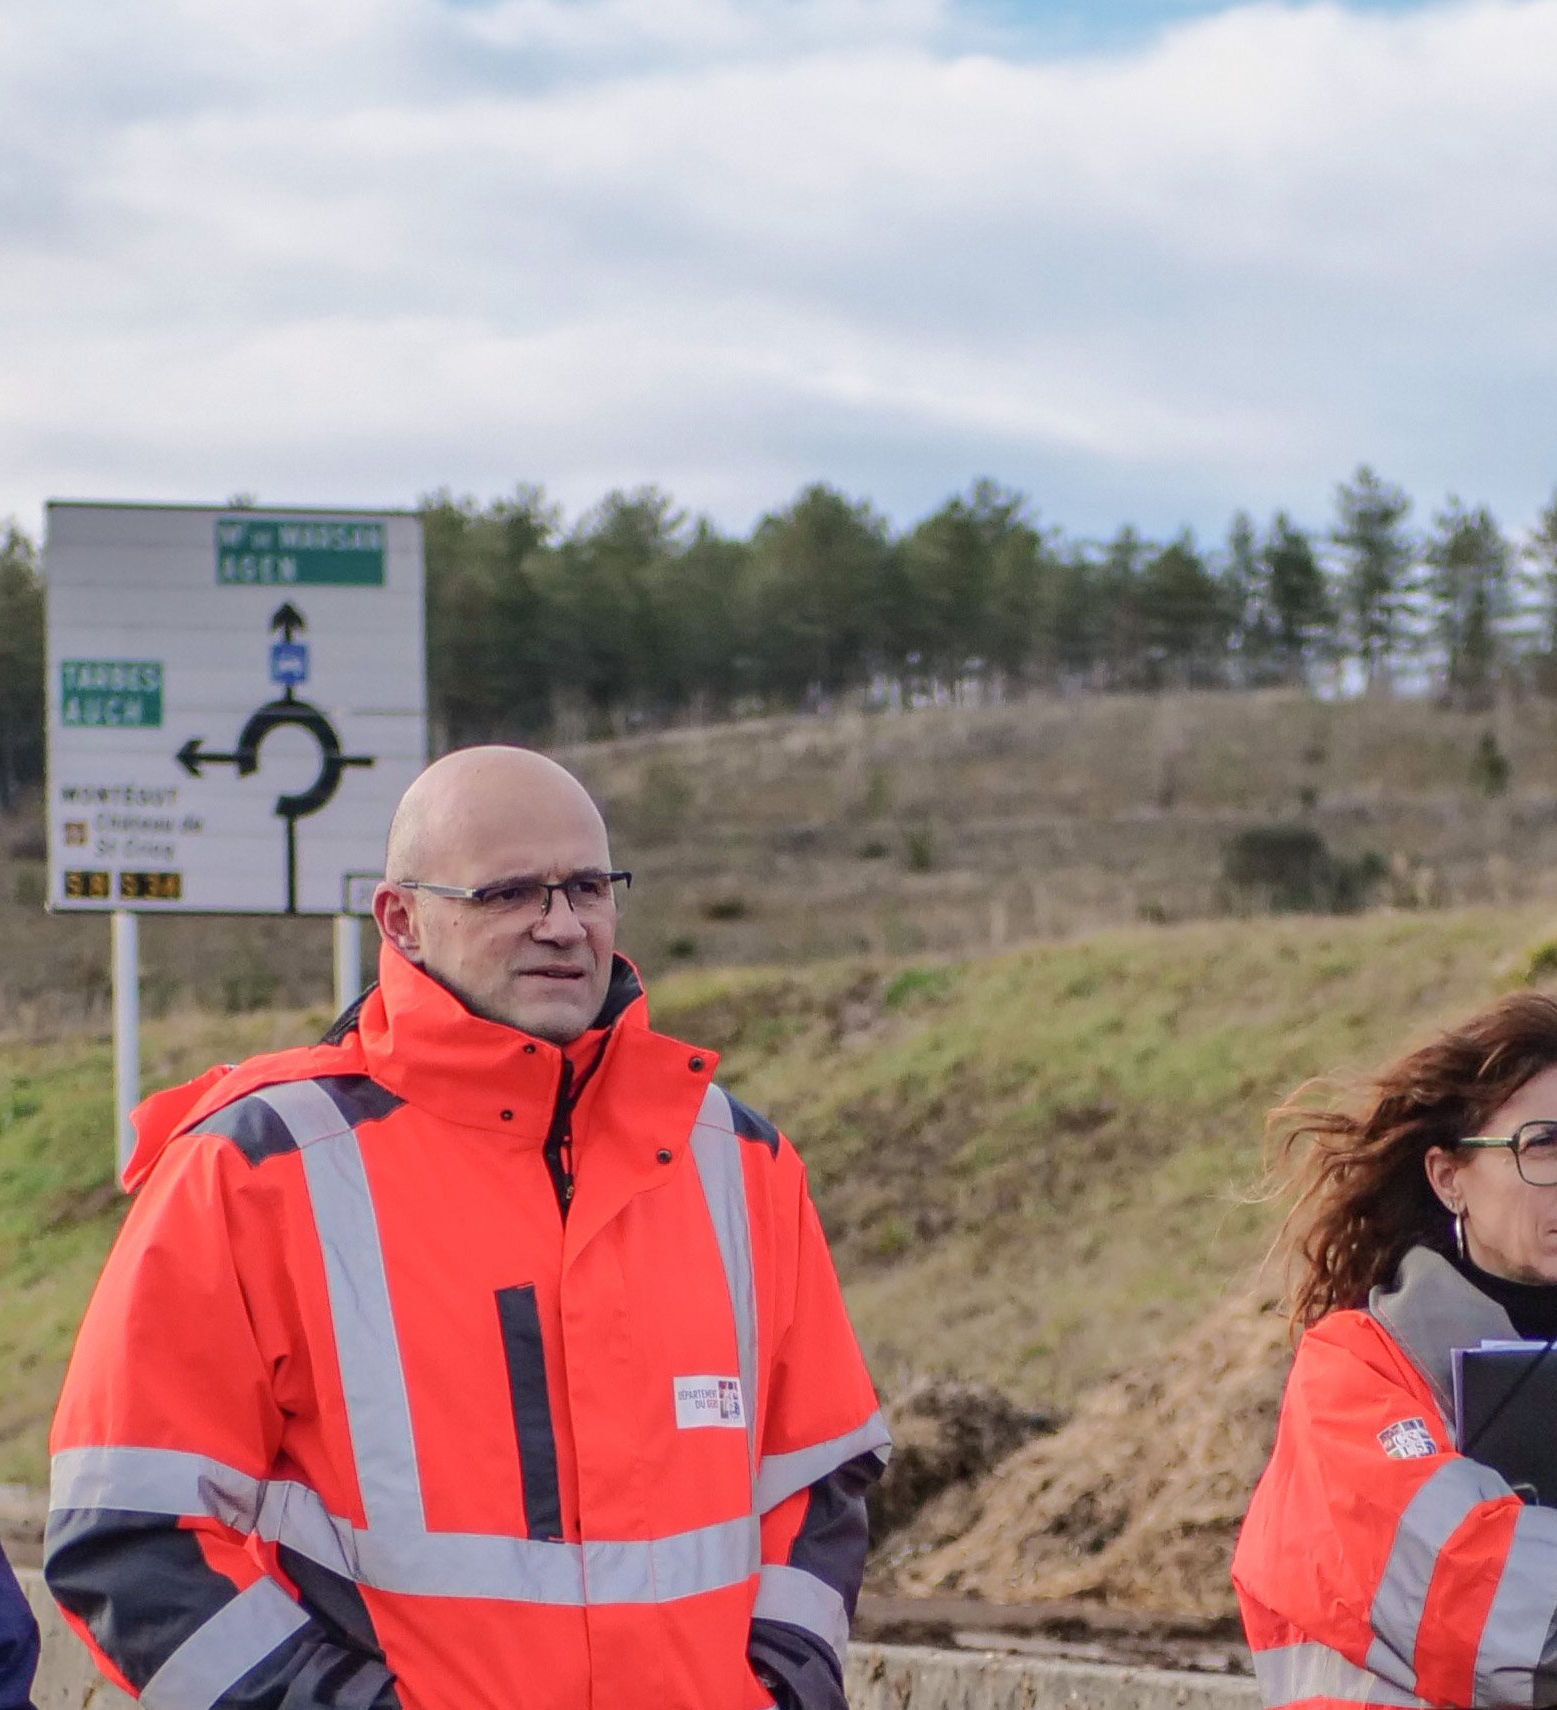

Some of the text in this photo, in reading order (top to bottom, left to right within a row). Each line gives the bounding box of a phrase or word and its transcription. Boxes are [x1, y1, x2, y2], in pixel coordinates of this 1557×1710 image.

[278, 525, 383, 551] MARSAN
[221, 554, 296, 582] AGEN
[63, 665, 158, 691] TARBES
[64, 697, 141, 724] AUCH
[695, 1400, 706, 1409] DU
